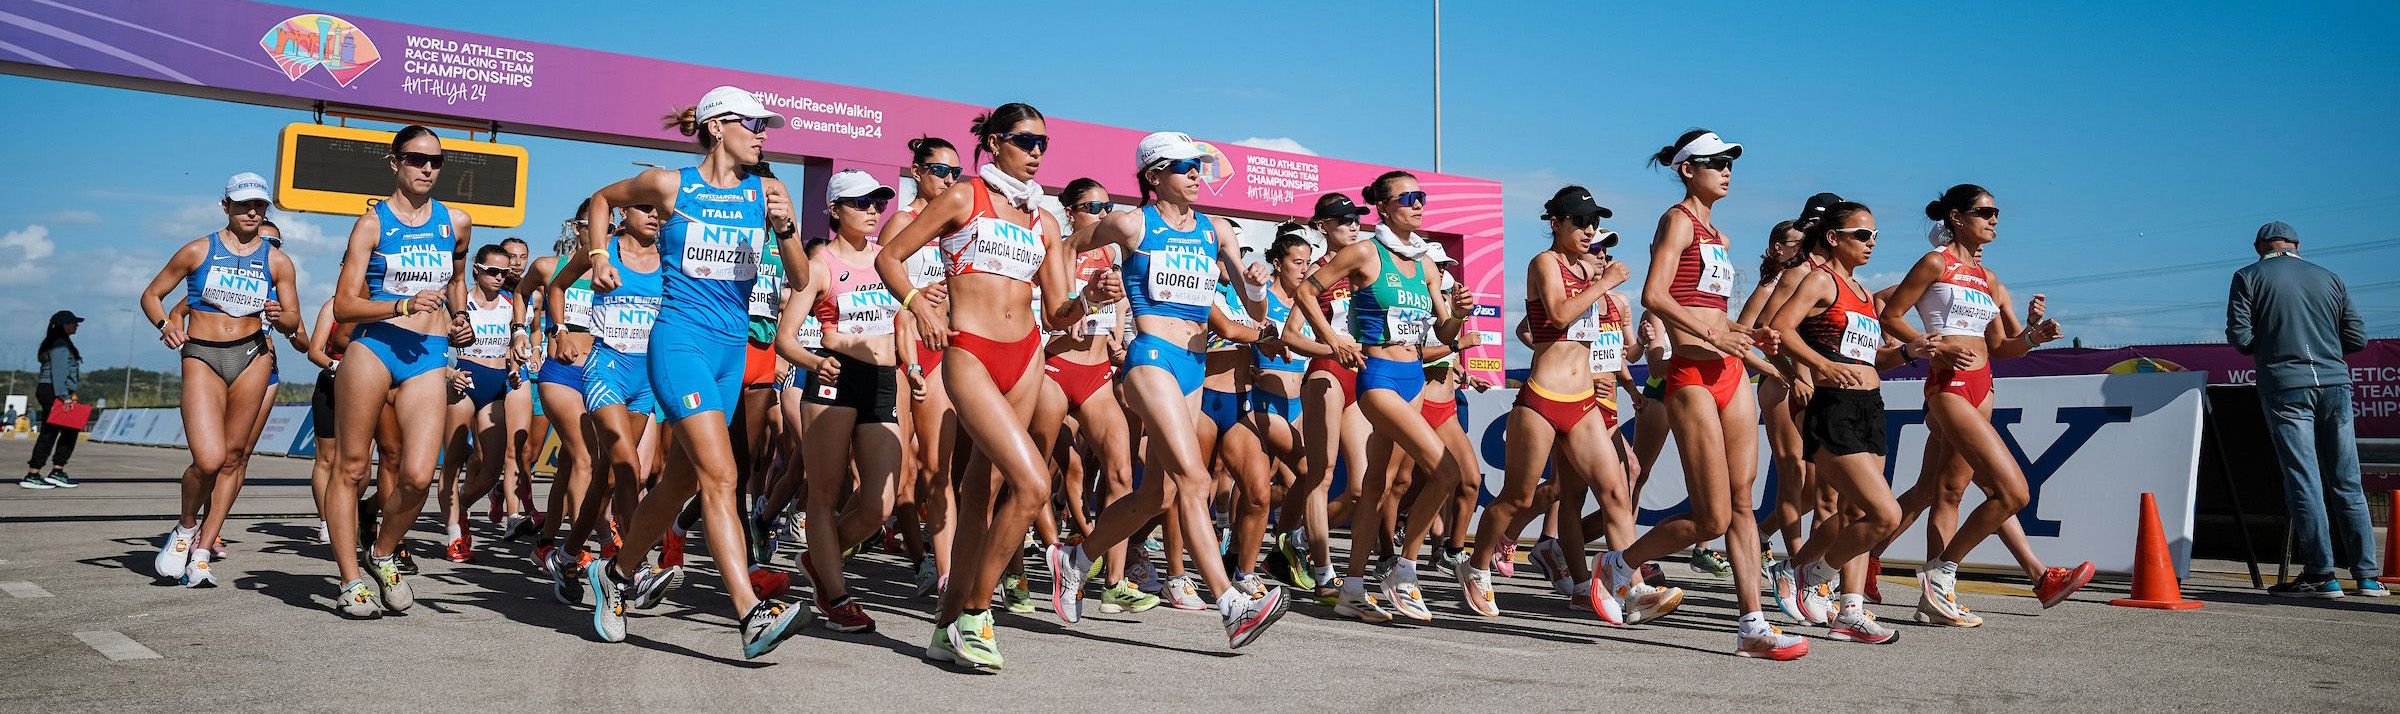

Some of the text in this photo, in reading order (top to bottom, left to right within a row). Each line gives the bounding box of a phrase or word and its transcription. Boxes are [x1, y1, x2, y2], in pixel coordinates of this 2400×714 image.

[406, 34, 535, 63] WORLD ATHLETICS
[404, 48, 534, 75] RACE WALKING TEAM
[403, 60, 533, 88] CHAMPIONSHIPS
[402, 75, 487, 105] ANTALYA 24
[790, 116, 883, 139] @waantalya24
[1246, 154, 1319, 173] WORLD ATHLETICS
[1246, 164, 1319, 183] RACE WALKING TEAM
[238, 183, 267, 191] ESTONI
[1246, 174, 1319, 193] CHAMPIONSHIPS
[1284, 189, 1295, 204] 24
[702, 208, 743, 219] ITALIA
[703, 225, 754, 247] NTN
[994, 221, 1034, 247] NTN
[400, 244, 437, 253] ITALIA
[687, 246, 746, 264] CURIAZZI
[978, 239, 1010, 257] GARCÍA
[1011, 246, 1030, 264] LEÓN
[1165, 245, 1206, 256] ITALIA
[400, 252, 442, 267] NTN
[1165, 253, 1209, 274] NTN
[211, 265, 266, 281] ESTONIA
[394, 271, 432, 283] MIHAI
[1156, 271, 1199, 290] GIORGI
[219, 274, 260, 294] NTN
[757, 276, 774, 290] TN
[851, 291, 892, 308] NTN
[1964, 288, 1993, 307] NTN
[619, 309, 657, 325] NTN
[848, 310, 882, 322] YANAI
[1857, 314, 1880, 333] NTN
[476, 323, 506, 335] NTN
[797, 328, 822, 338] CARR
[1397, 324, 1421, 336] SENA
[1592, 348, 1615, 361] PENG
[1469, 359, 1501, 370] SEIKO
